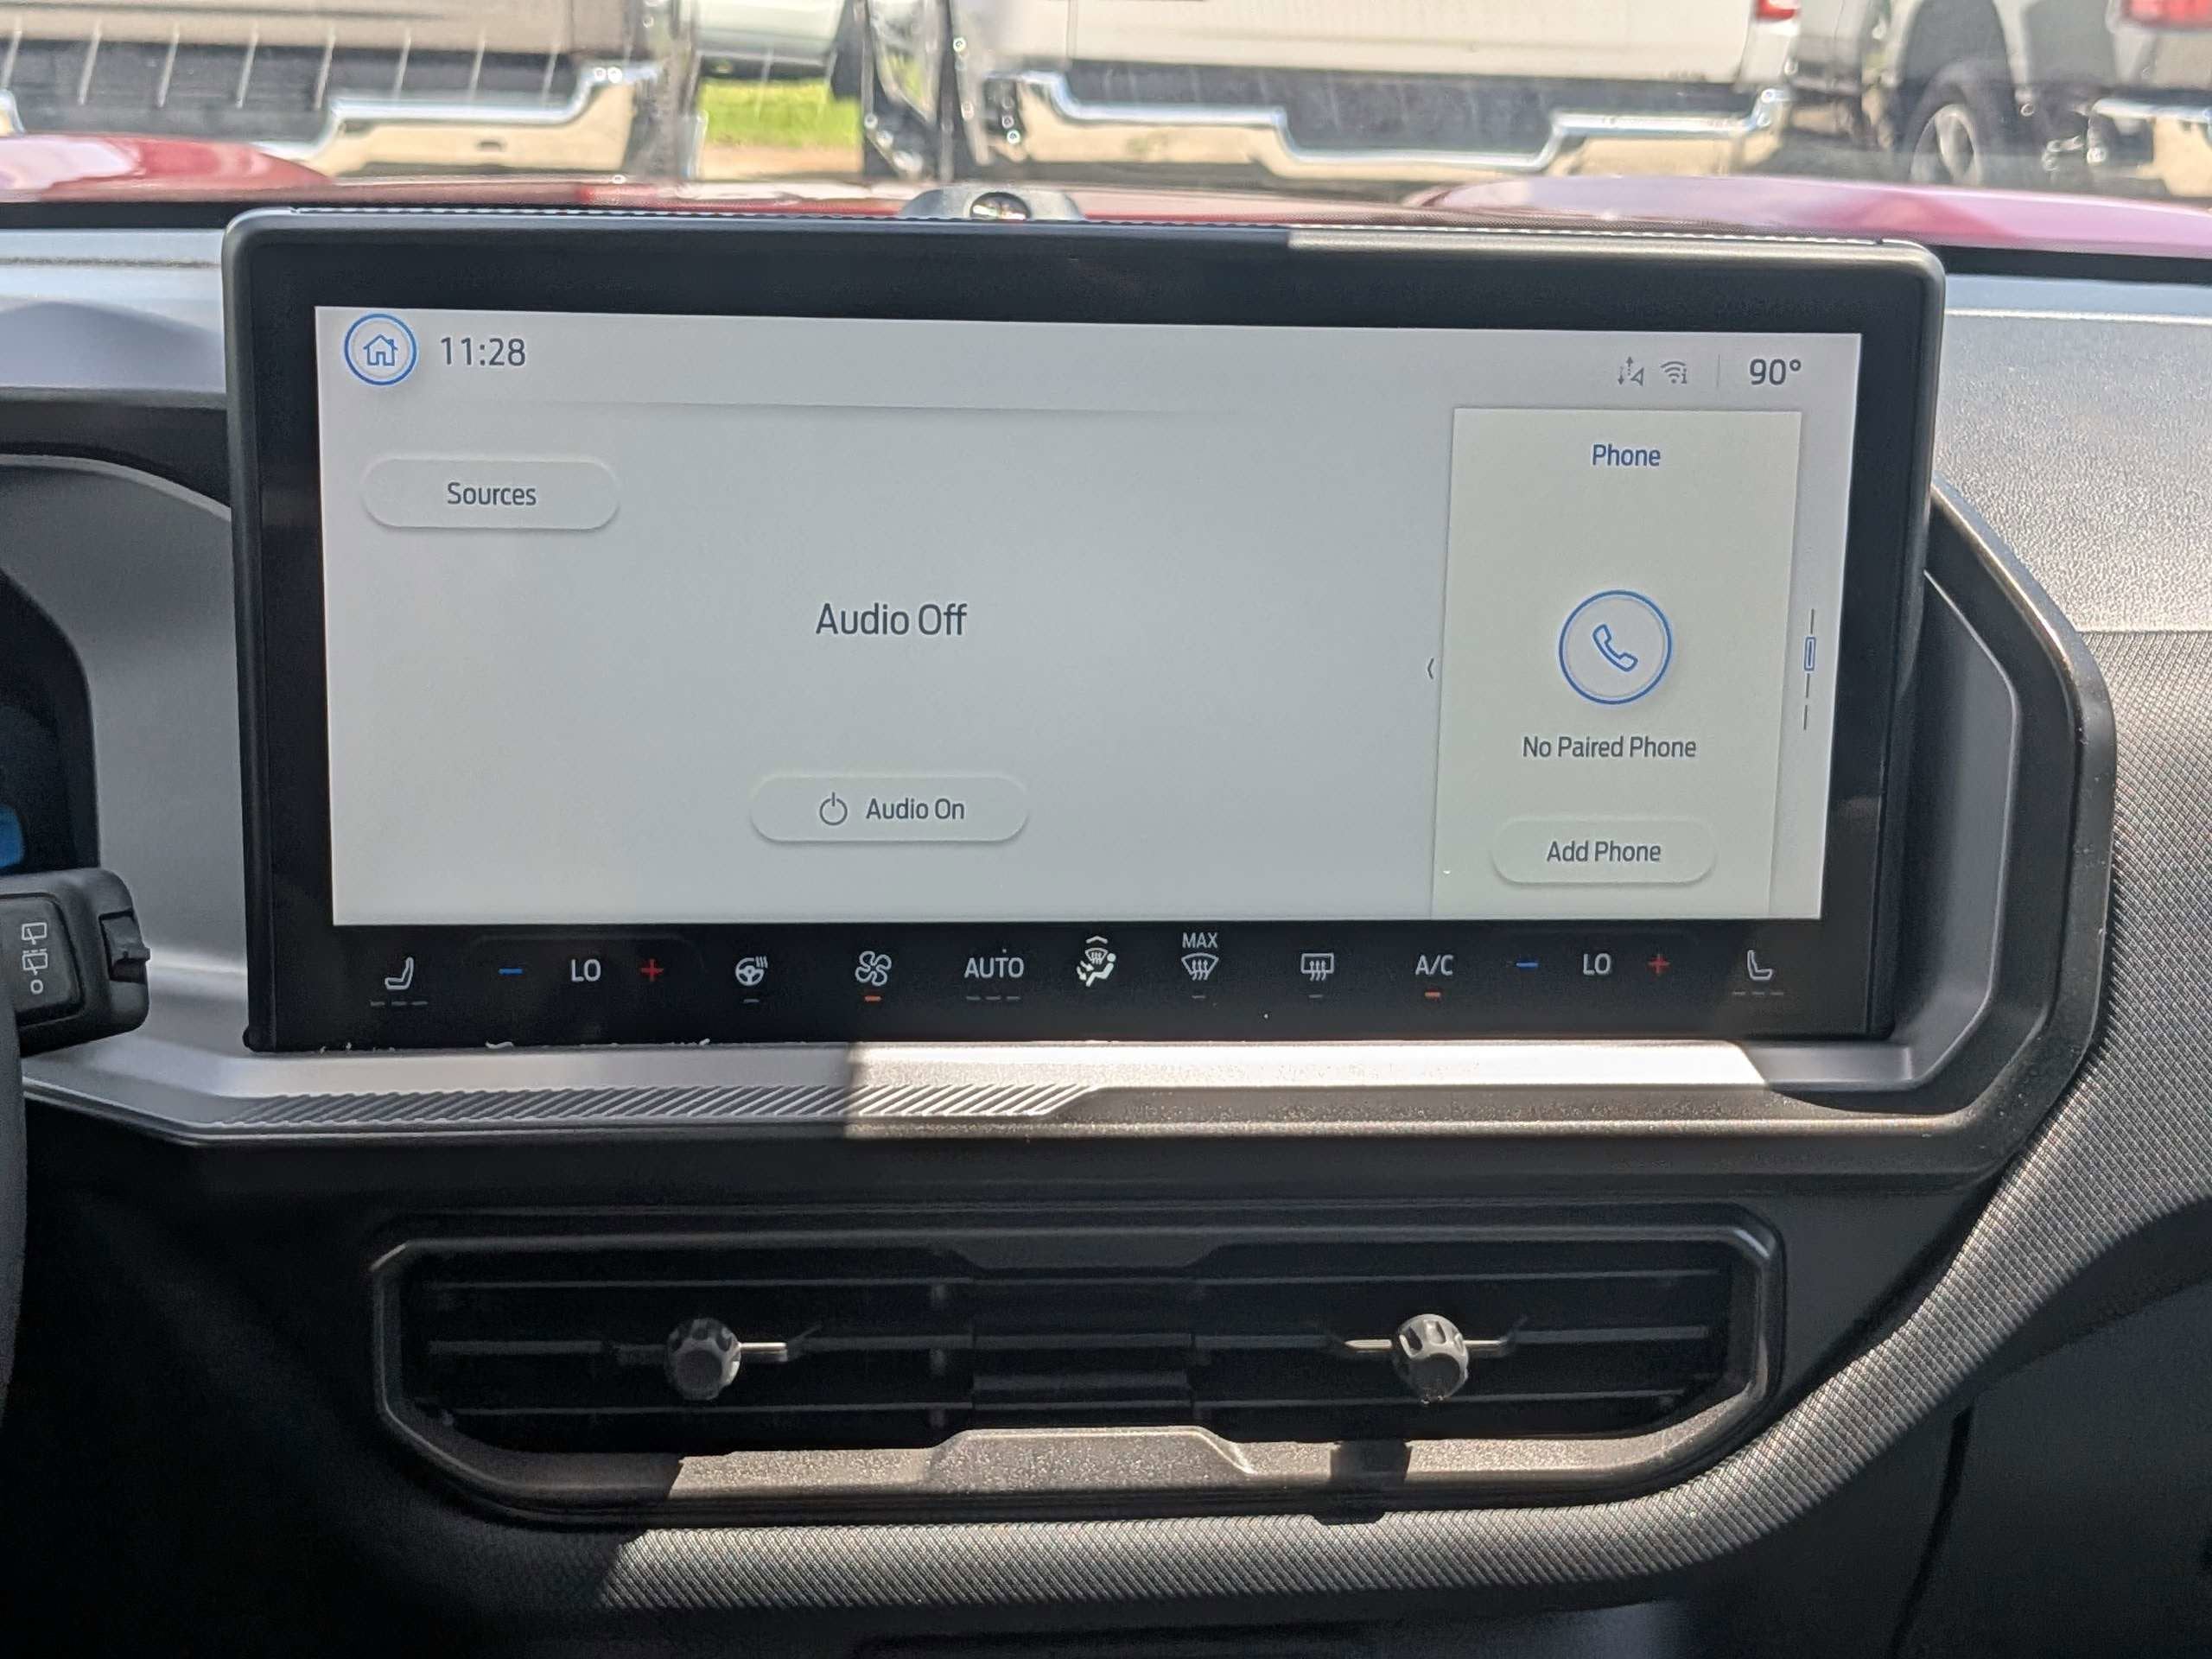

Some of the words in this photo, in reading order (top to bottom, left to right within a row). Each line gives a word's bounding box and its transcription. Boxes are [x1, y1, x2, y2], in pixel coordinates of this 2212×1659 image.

[440, 336, 526, 367] 11:28
[1749, 358, 1802, 386] 90°
[1592, 442, 1662, 467] Phone
[447, 481, 537, 506] Sources
[815, 601, 910, 636] Audio
[918, 602, 969, 636] Off
[1522, 735, 1553, 758] No
[1557, 734, 1624, 759] Paired
[1629, 734, 1697, 759] Phone
[865, 797, 929, 821] Audio
[934, 798, 965, 820] On
[1546, 839, 1590, 862] Add
[1594, 839, 1662, 863] Phone
[1181, 931, 1218, 949] MAX
[570, 958, 601, 982] LO
[963, 957, 1025, 979] AUTO
[1414, 954, 1454, 976] A/C
[1582, 952, 1611, 976] LO
